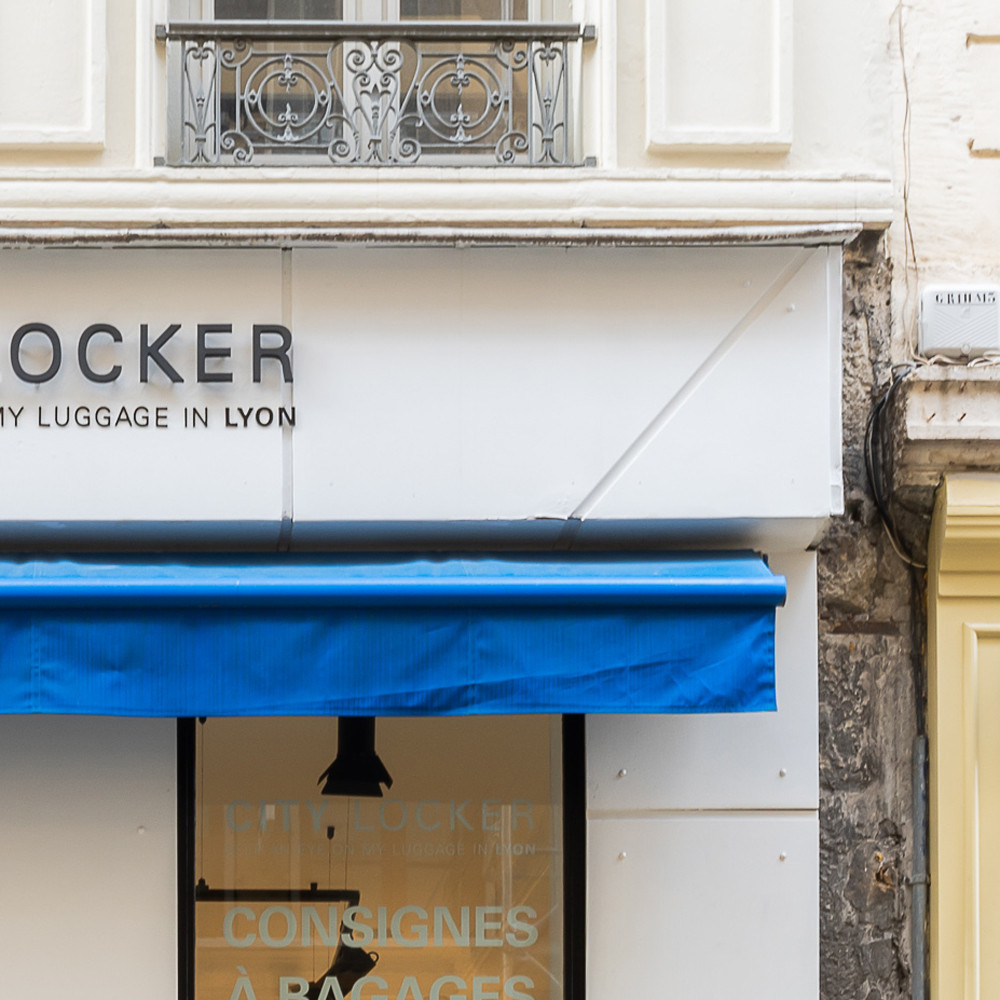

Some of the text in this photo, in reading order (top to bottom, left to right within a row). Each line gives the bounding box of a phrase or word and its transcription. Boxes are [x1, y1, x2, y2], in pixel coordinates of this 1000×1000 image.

[37, 406, 169, 429] LUGGAGE
[184, 406, 209, 429] IN
[224, 406, 297, 429] LYON
[224, 799, 536, 832] CITY LOCKER
[495, 843, 537, 856] LYON
[222, 905, 539, 948] CONSIGNES
